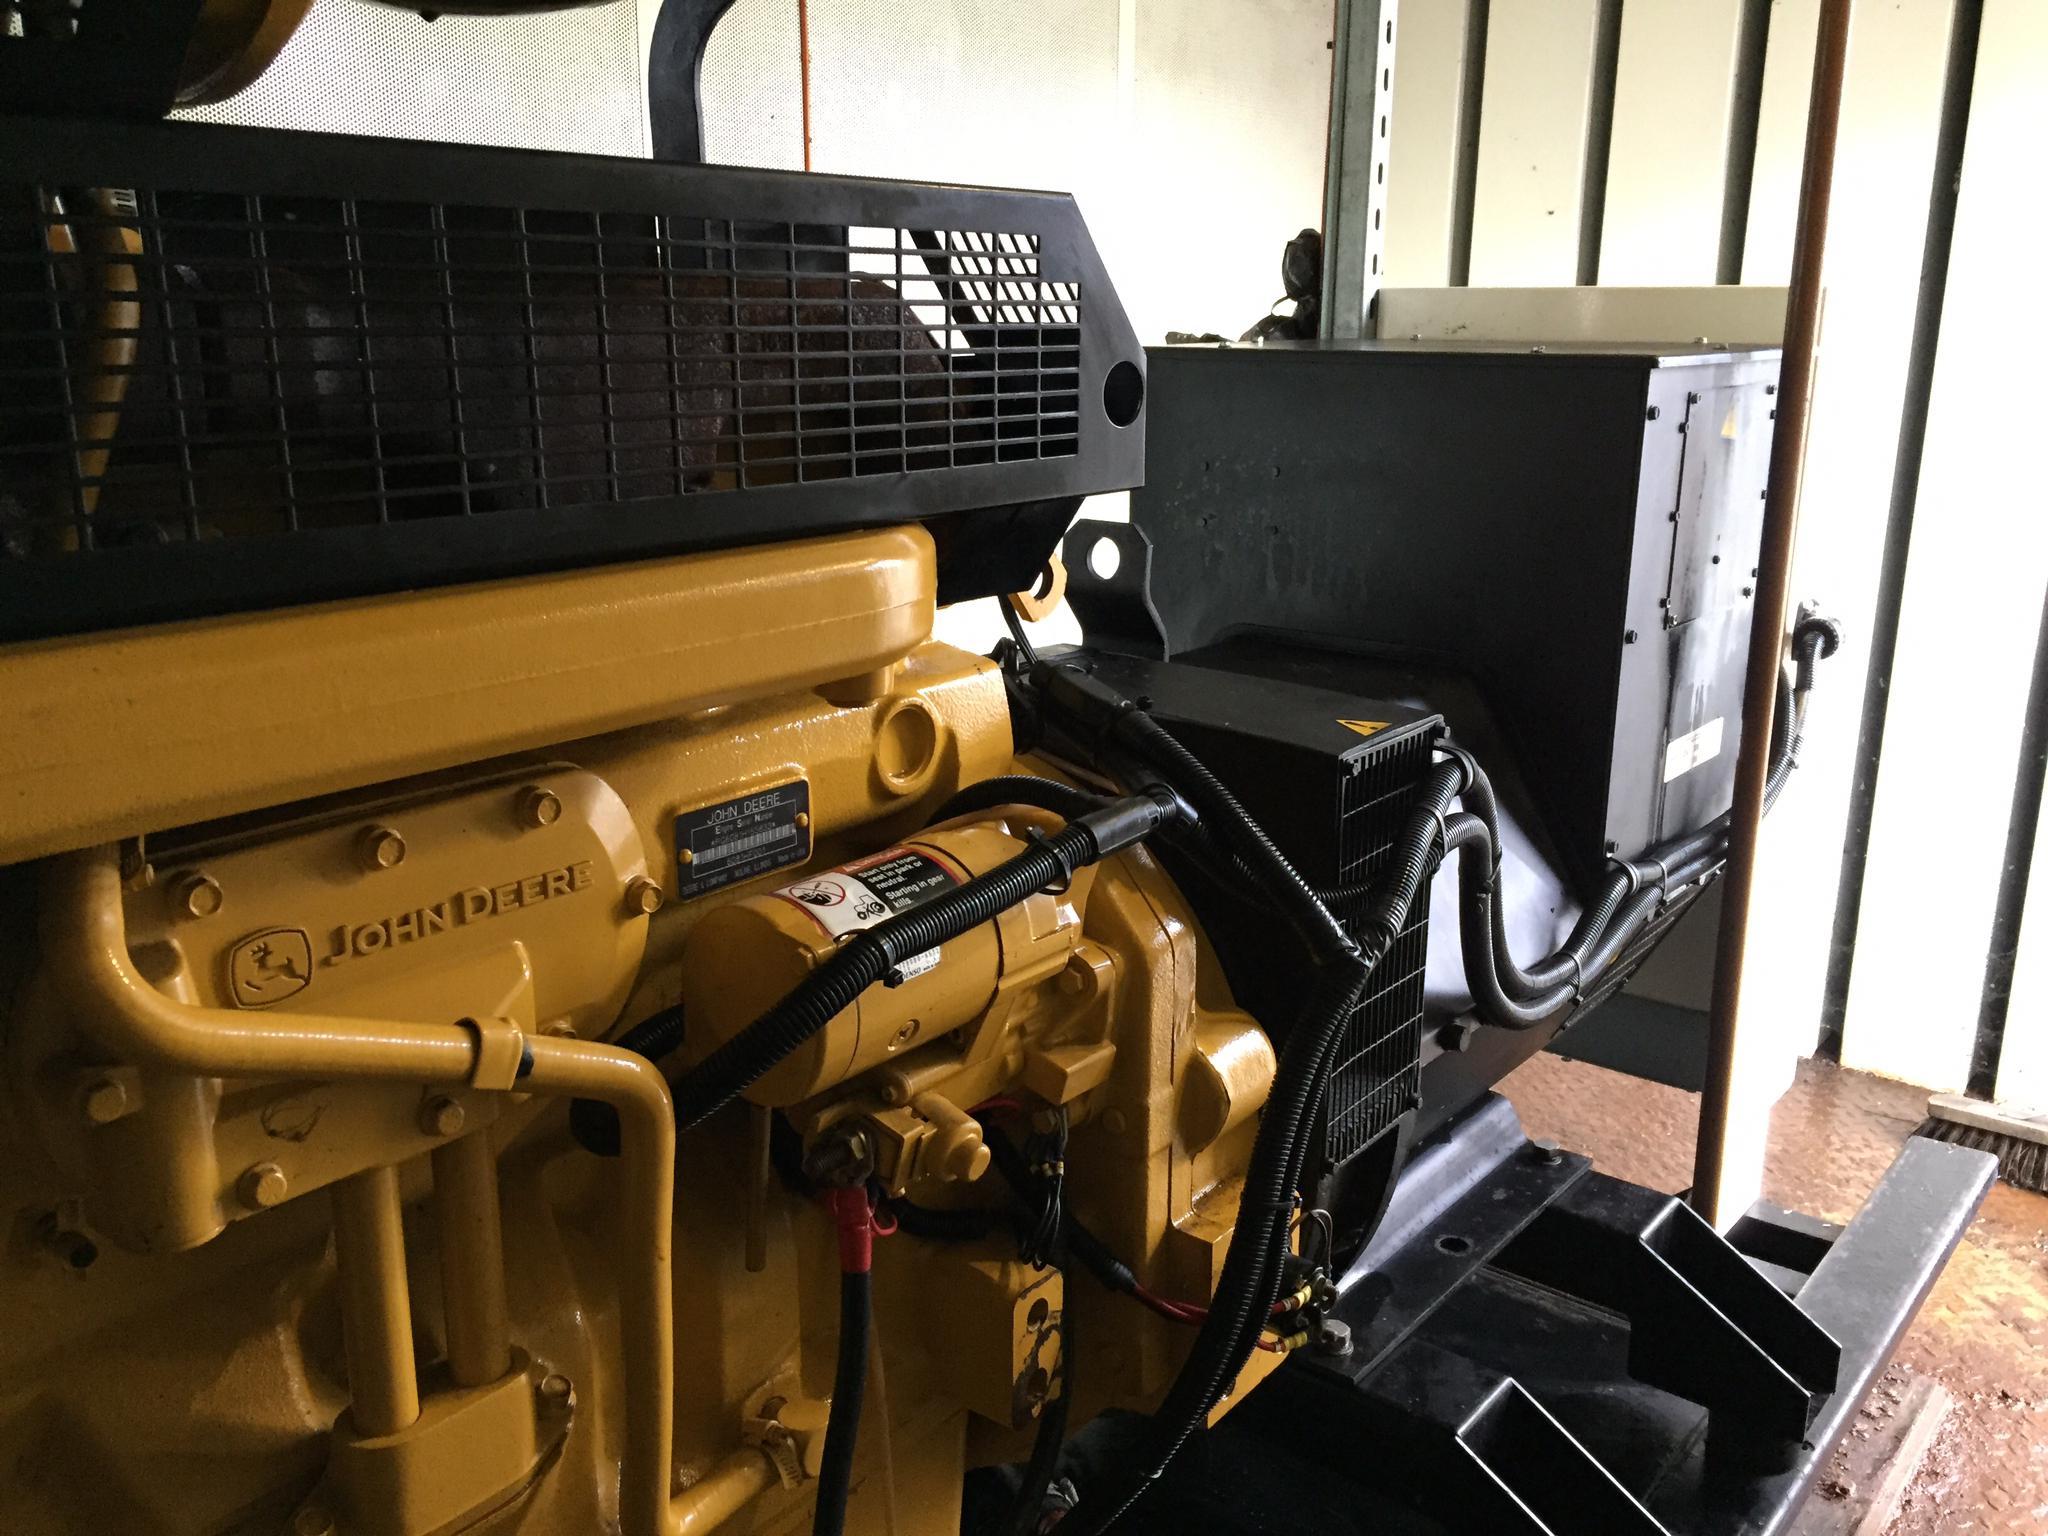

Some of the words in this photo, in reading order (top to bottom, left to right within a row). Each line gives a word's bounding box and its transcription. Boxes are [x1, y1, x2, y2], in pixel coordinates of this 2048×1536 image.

[707, 805, 738, 825] JOHN
[744, 792, 781, 814] DEERE
[867, 873, 887, 883] seat
[895, 864, 914, 875] park
[885, 884, 920, 900] Starting
[927, 874, 945, 886] gear
[326, 903, 450, 965] JOHN
[461, 860, 594, 924] DEERE
